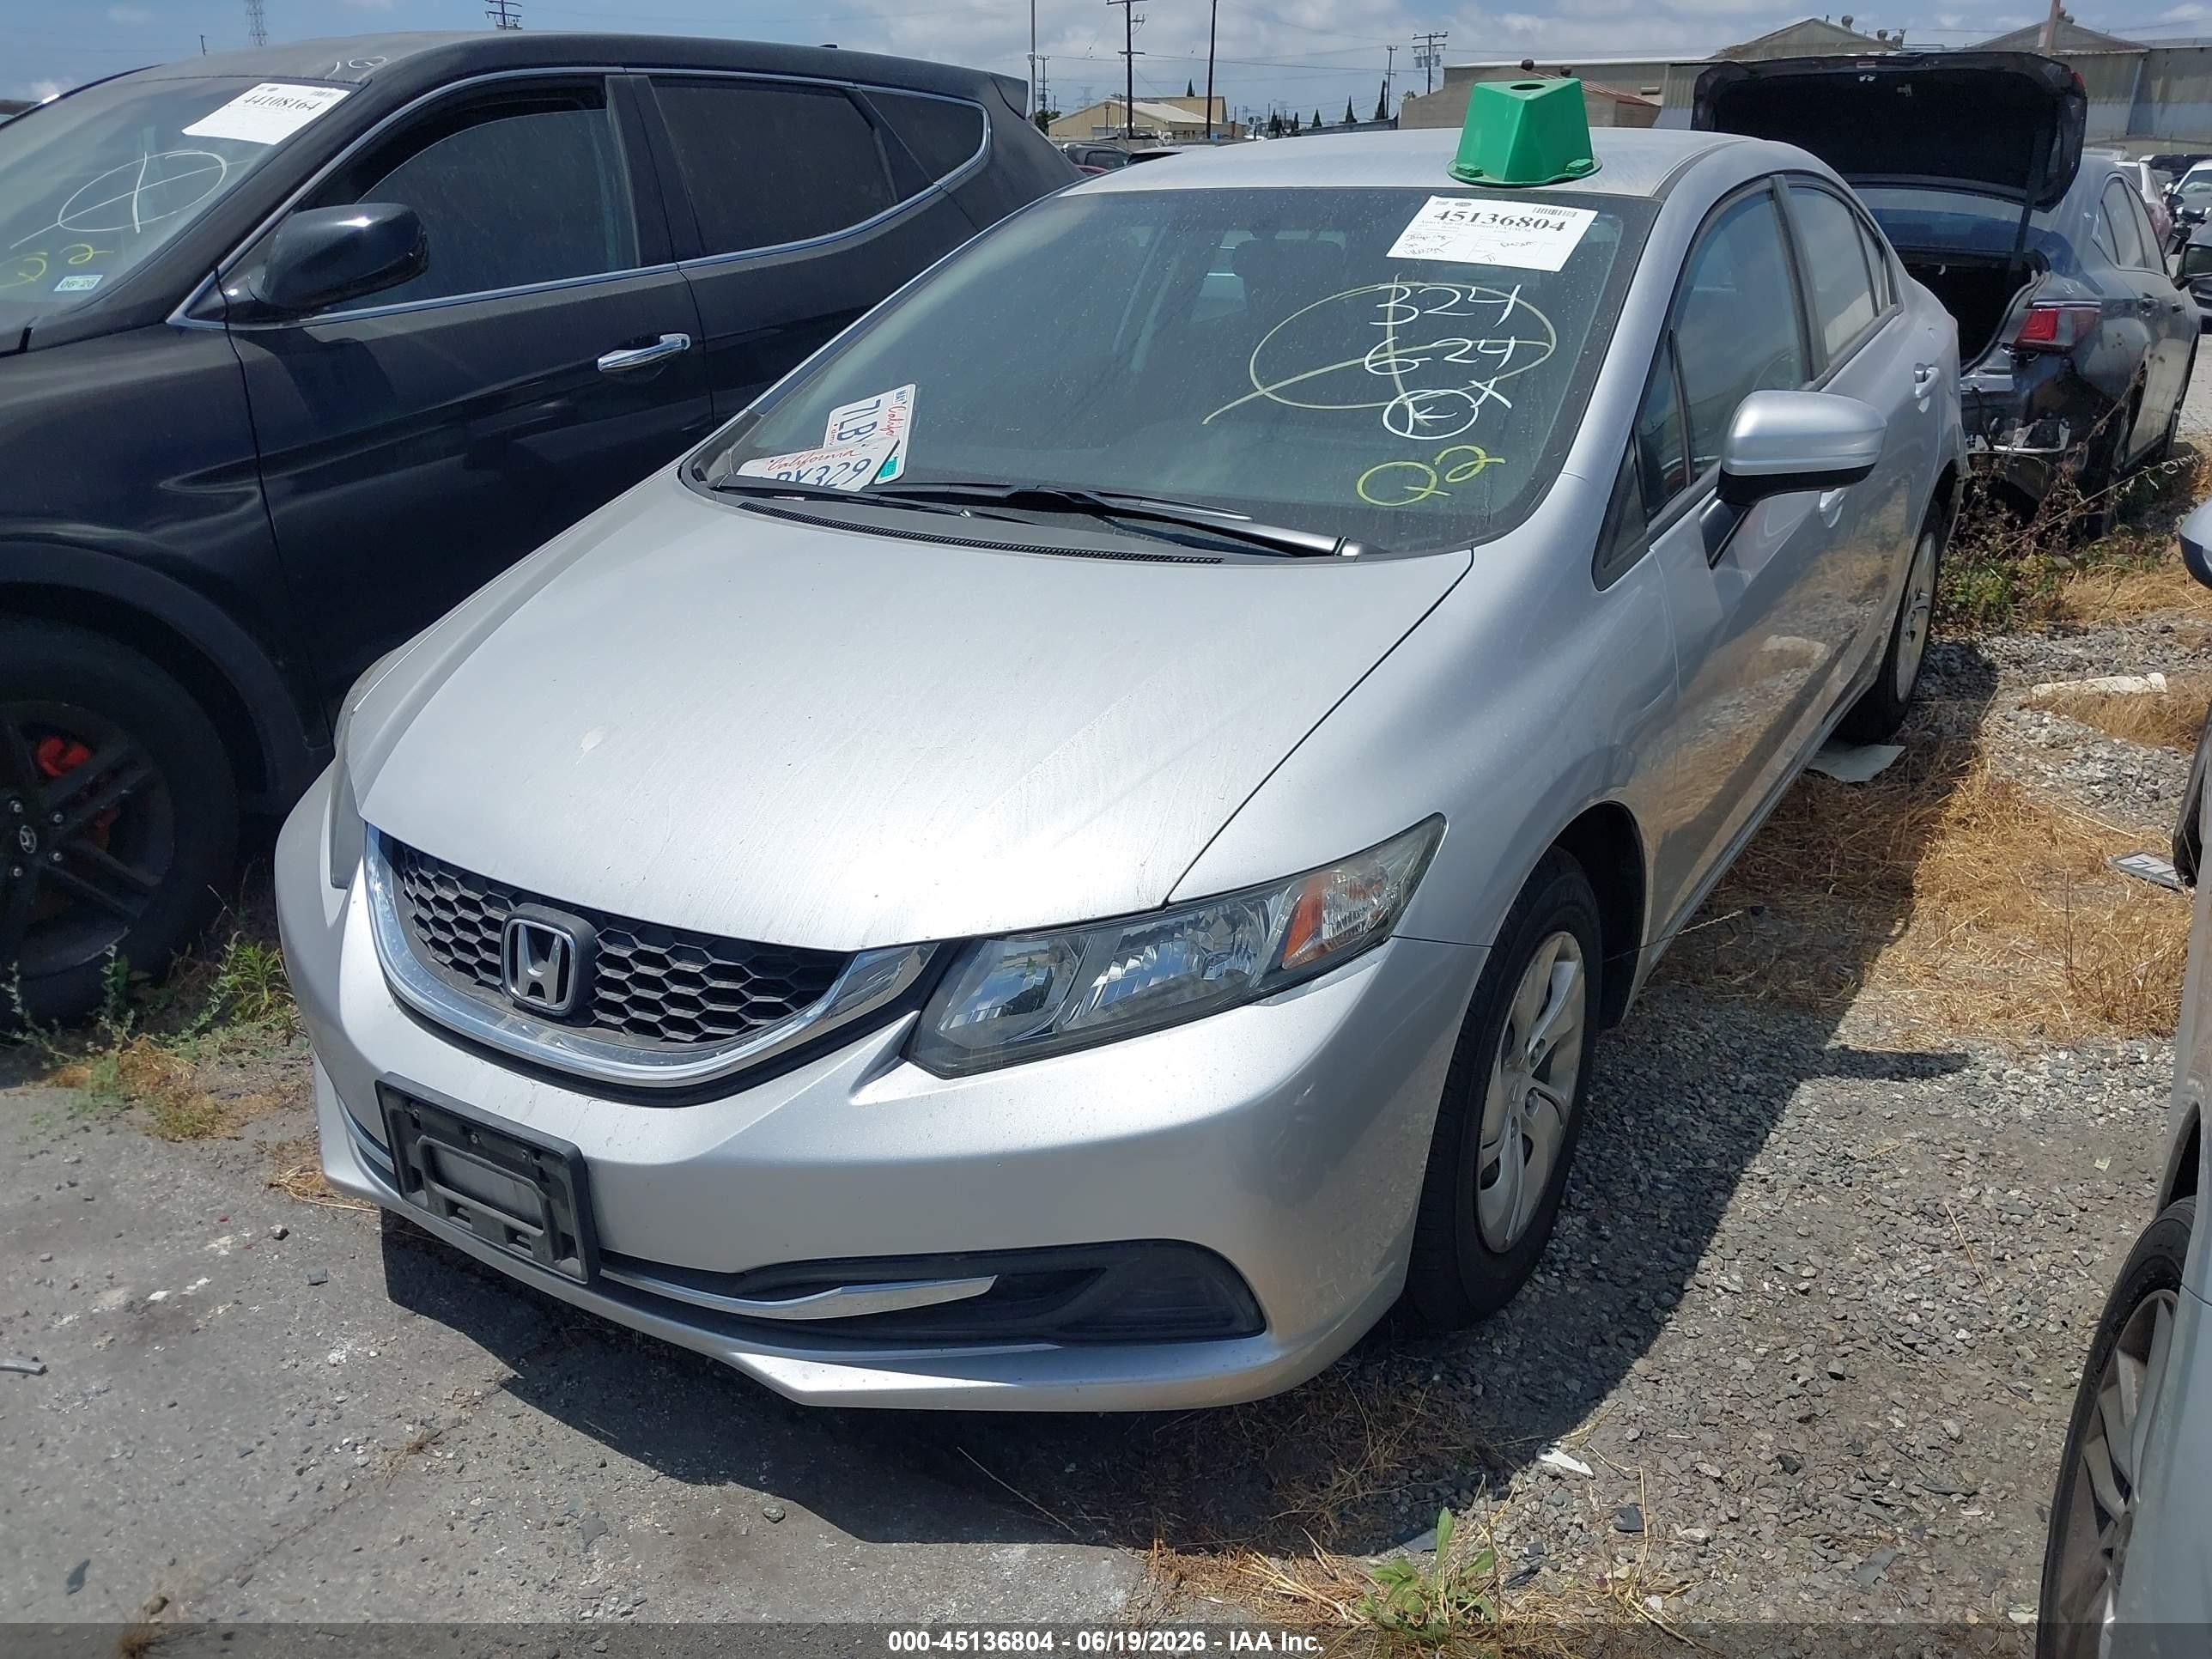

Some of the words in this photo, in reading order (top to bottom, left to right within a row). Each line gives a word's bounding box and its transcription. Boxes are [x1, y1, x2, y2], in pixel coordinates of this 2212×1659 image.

[241, 94, 323, 112] 44108164
[1433, 210, 1566, 232] 45136804
[1369, 284, 1521, 329] 324
[767, 448, 862, 471] California
[1356, 444, 1506, 507] Q2
